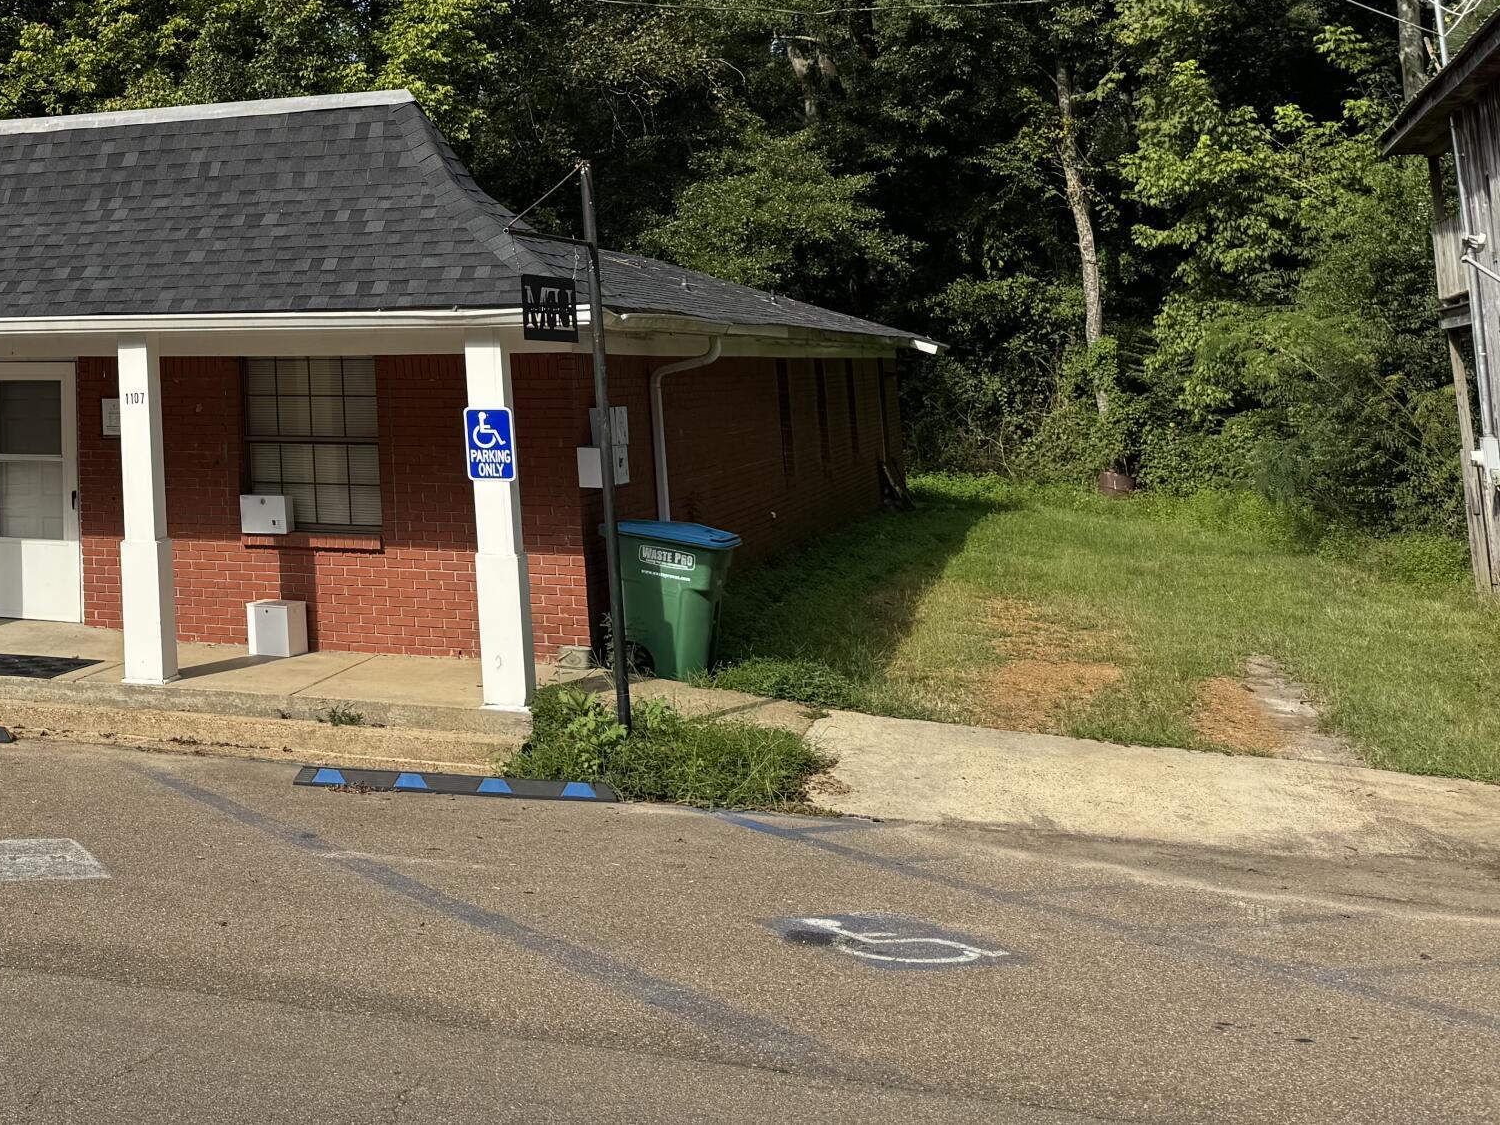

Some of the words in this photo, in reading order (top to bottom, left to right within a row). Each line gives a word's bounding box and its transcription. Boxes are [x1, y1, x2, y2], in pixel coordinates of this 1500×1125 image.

[125, 392, 145, 405] 1107
[470, 449, 511, 463] PARKING
[478, 463, 504, 477] ONLY
[642, 546, 672, 562] WASTE
[674, 552, 693, 566] PRO
